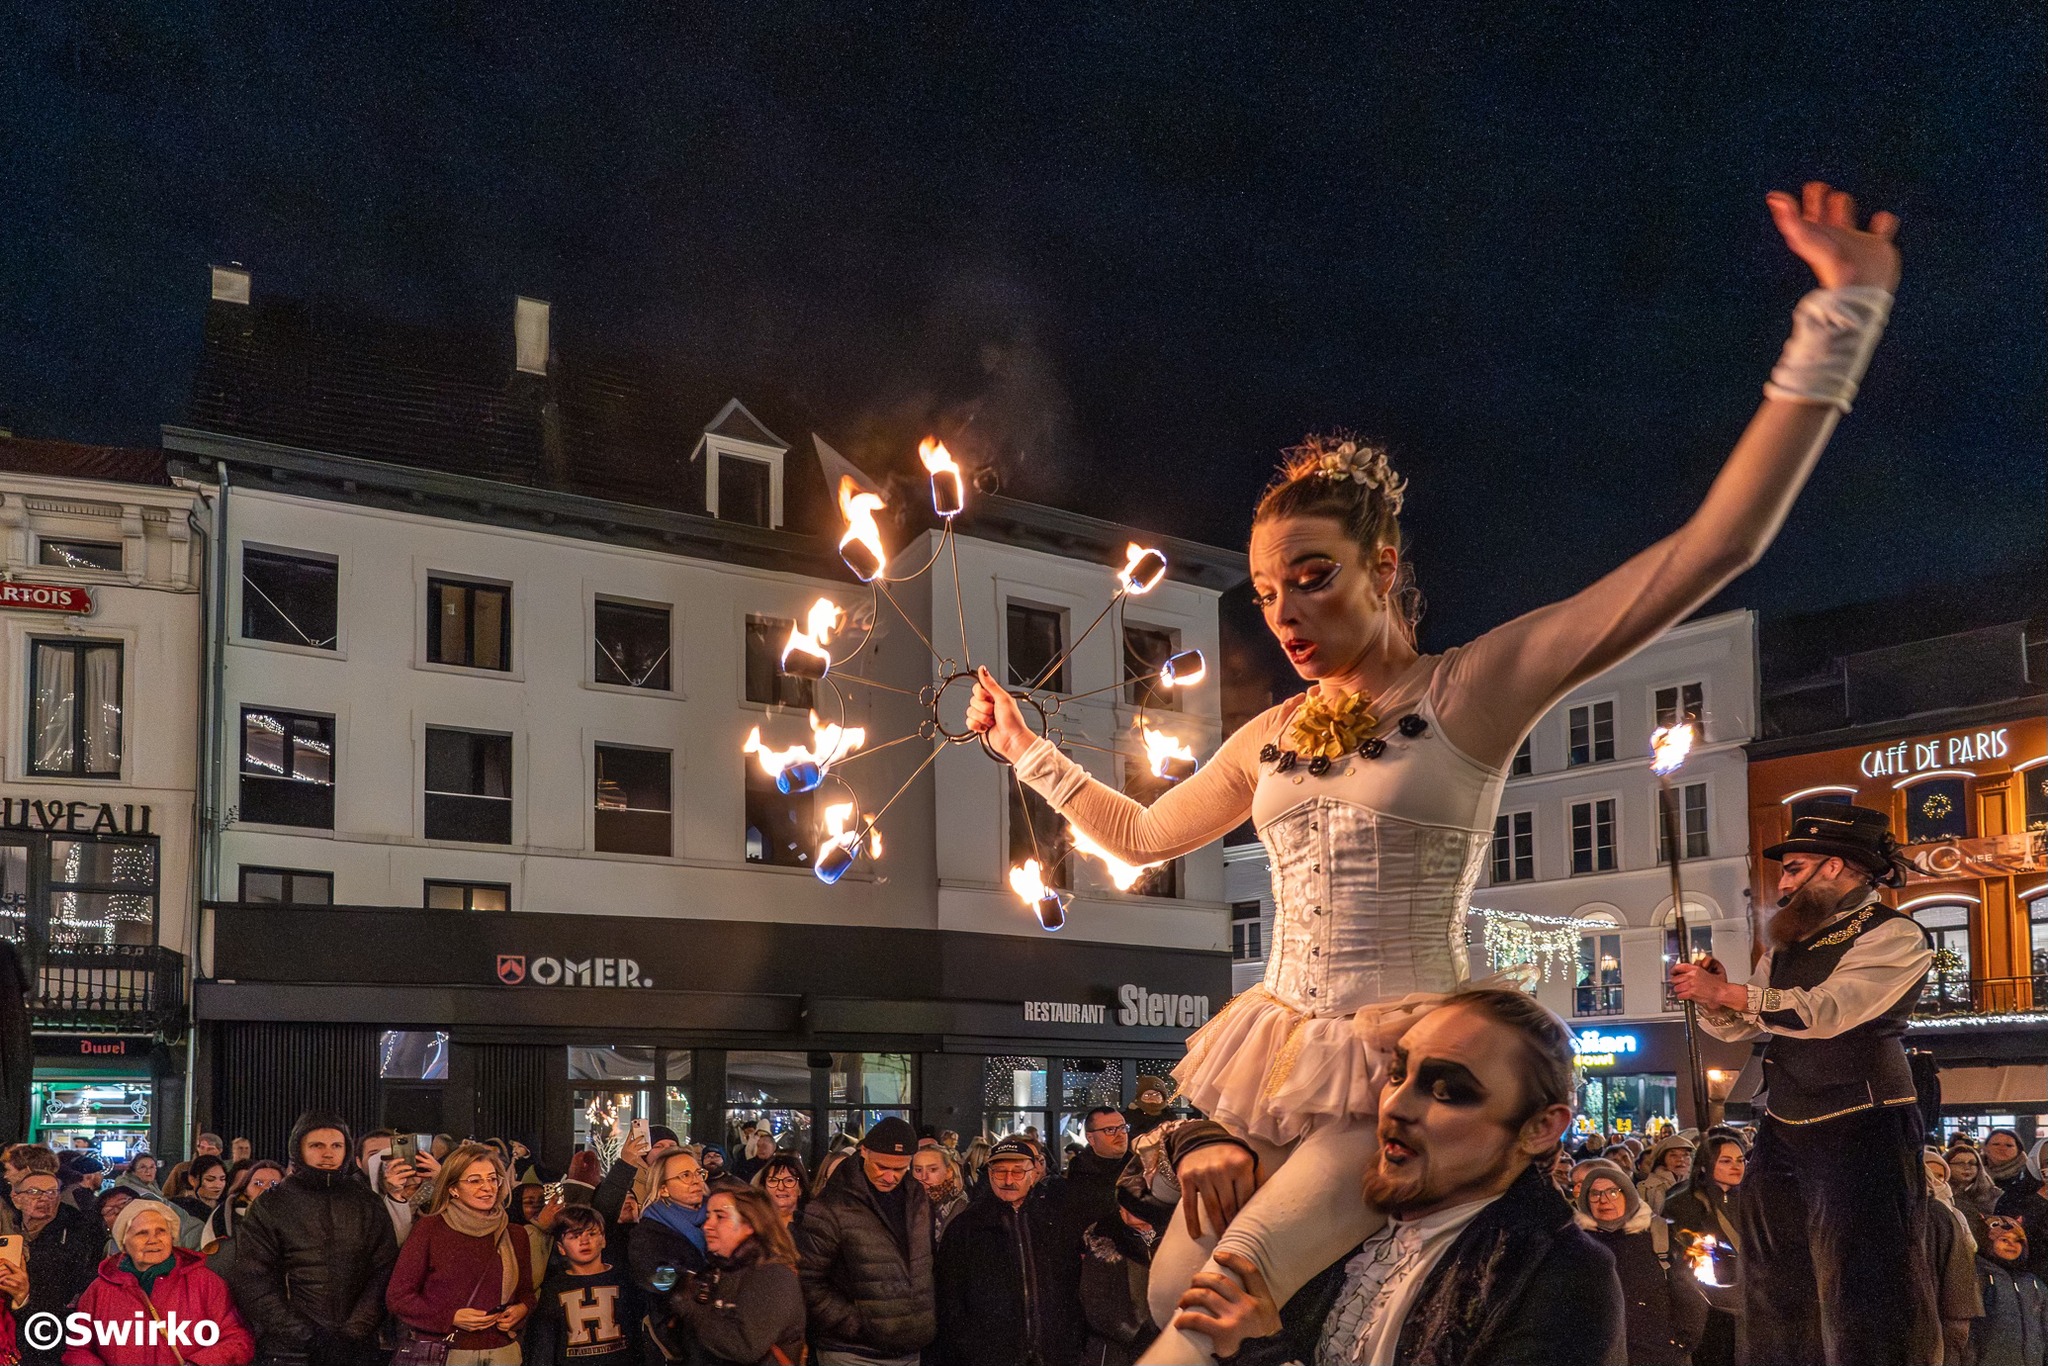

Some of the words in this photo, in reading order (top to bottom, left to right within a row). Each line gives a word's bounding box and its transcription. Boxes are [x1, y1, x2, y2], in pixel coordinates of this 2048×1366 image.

[0, 587, 72, 605] RTOIS
[1860, 740, 1909, 778] CAFÉ
[1915, 740, 1942, 771] DE
[1949, 728, 2008, 765] PARIS
[0, 797, 154, 836] UVEAU
[531, 957, 653, 987] OMER.
[1024, 1001, 1106, 1024] RESTAURANT
[1118, 984, 1209, 1028] Steven
[80, 1039, 125, 1055] Duvel
[559, 1285, 620, 1346] H
